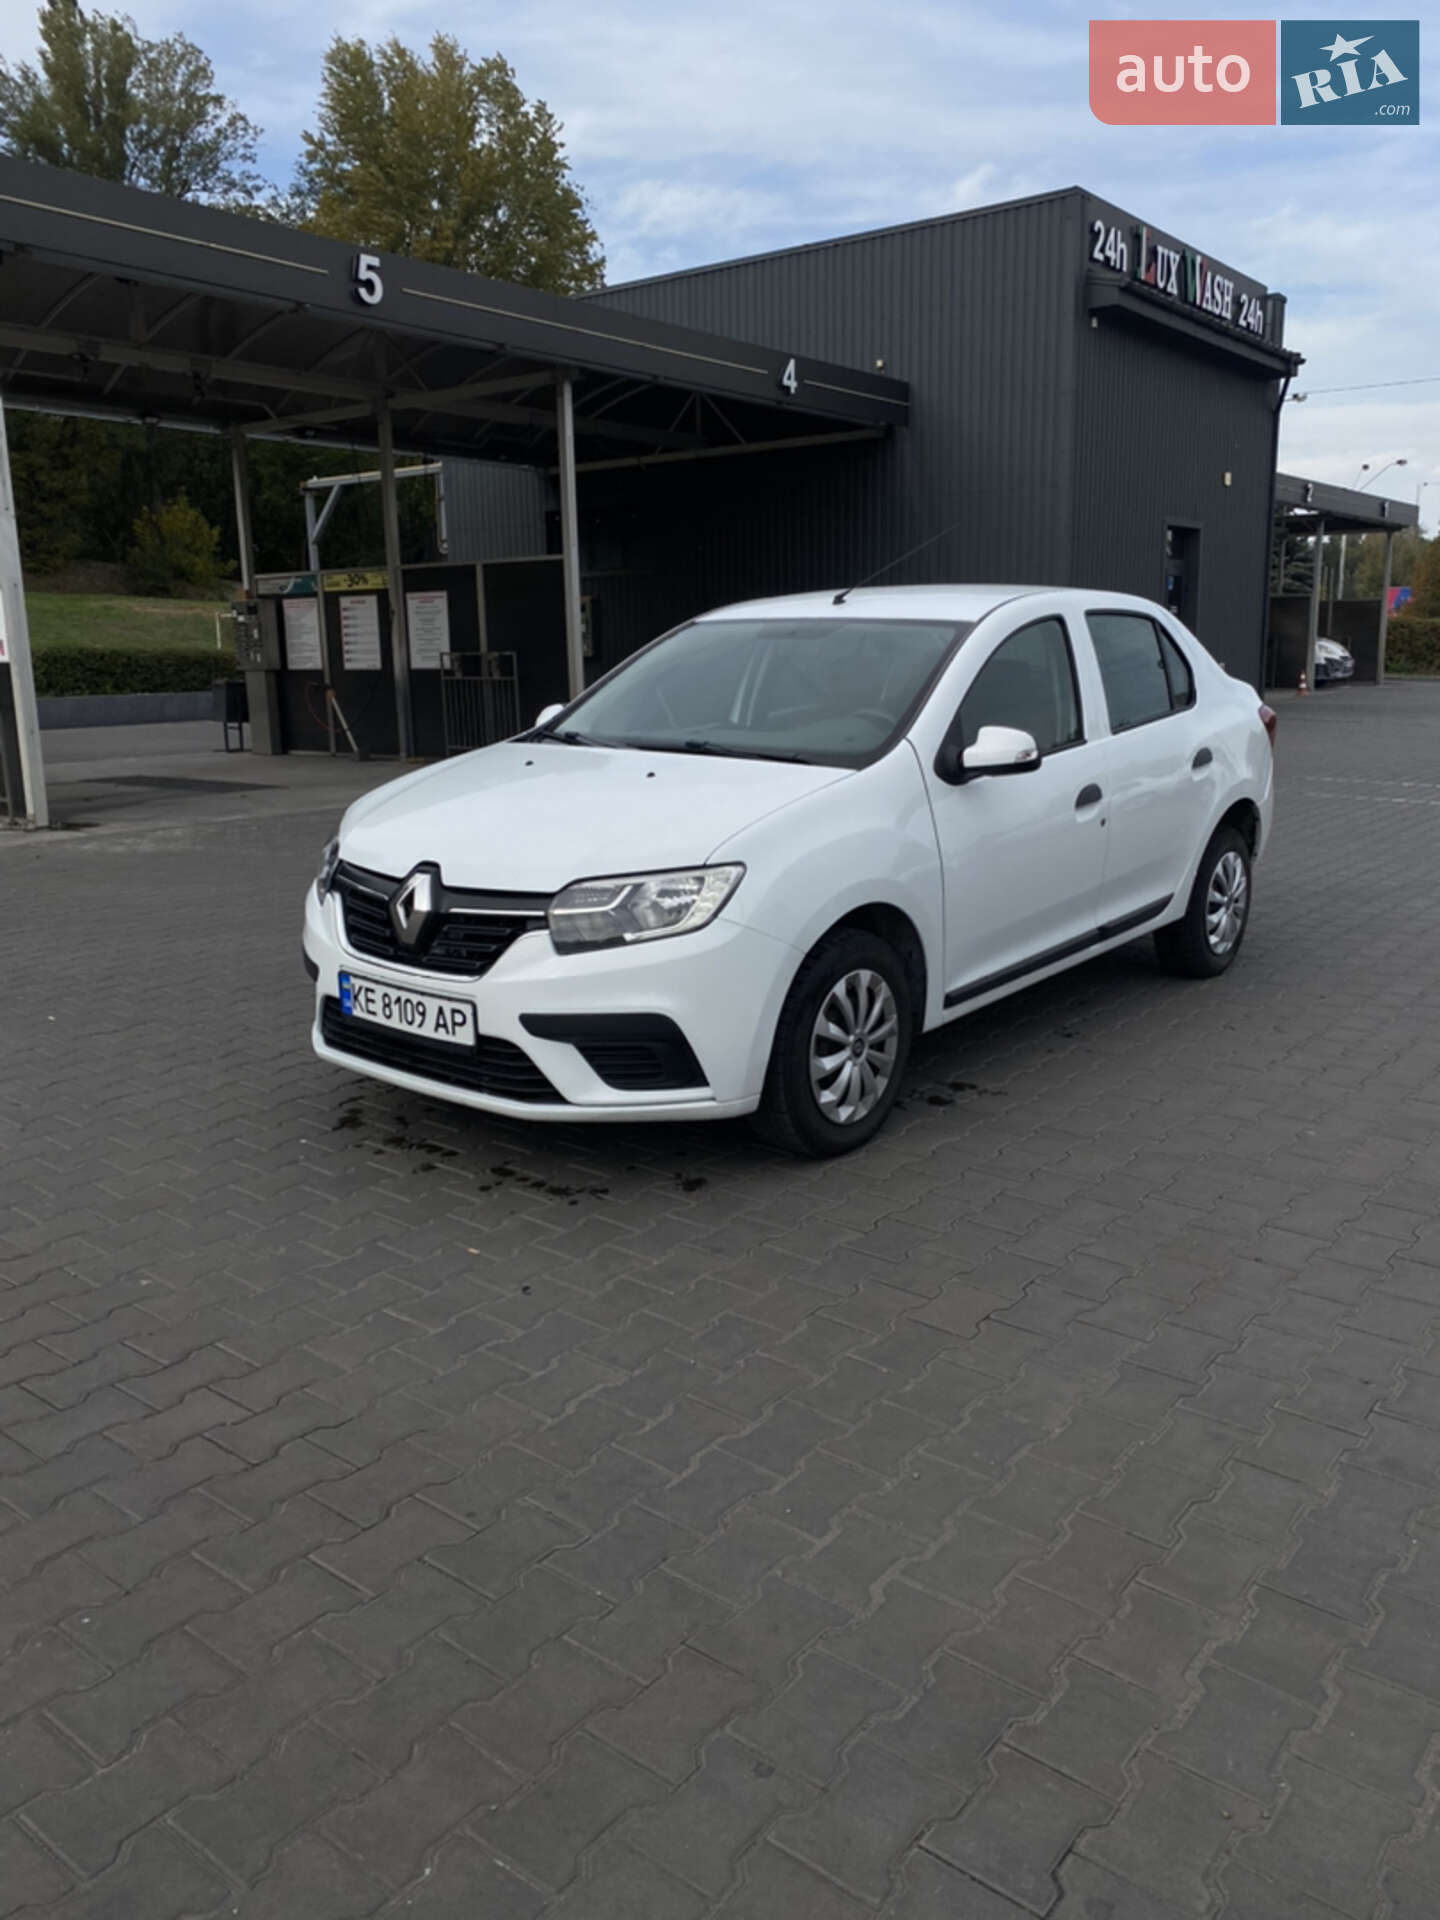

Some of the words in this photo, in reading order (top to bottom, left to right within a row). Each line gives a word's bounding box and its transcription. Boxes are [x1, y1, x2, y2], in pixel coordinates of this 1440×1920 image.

[357, 252, 384, 305] 5
[1092, 219, 1128, 272] 24h
[1136, 225, 1180, 296] LUX
[1184, 249, 1235, 320] WASH
[1238, 293, 1264, 335] 24h
[782, 357, 798, 395] 4
[352, 983, 377, 1016] KE
[381, 992, 427, 1028] 8109
[434, 1005, 467, 1036] AP
